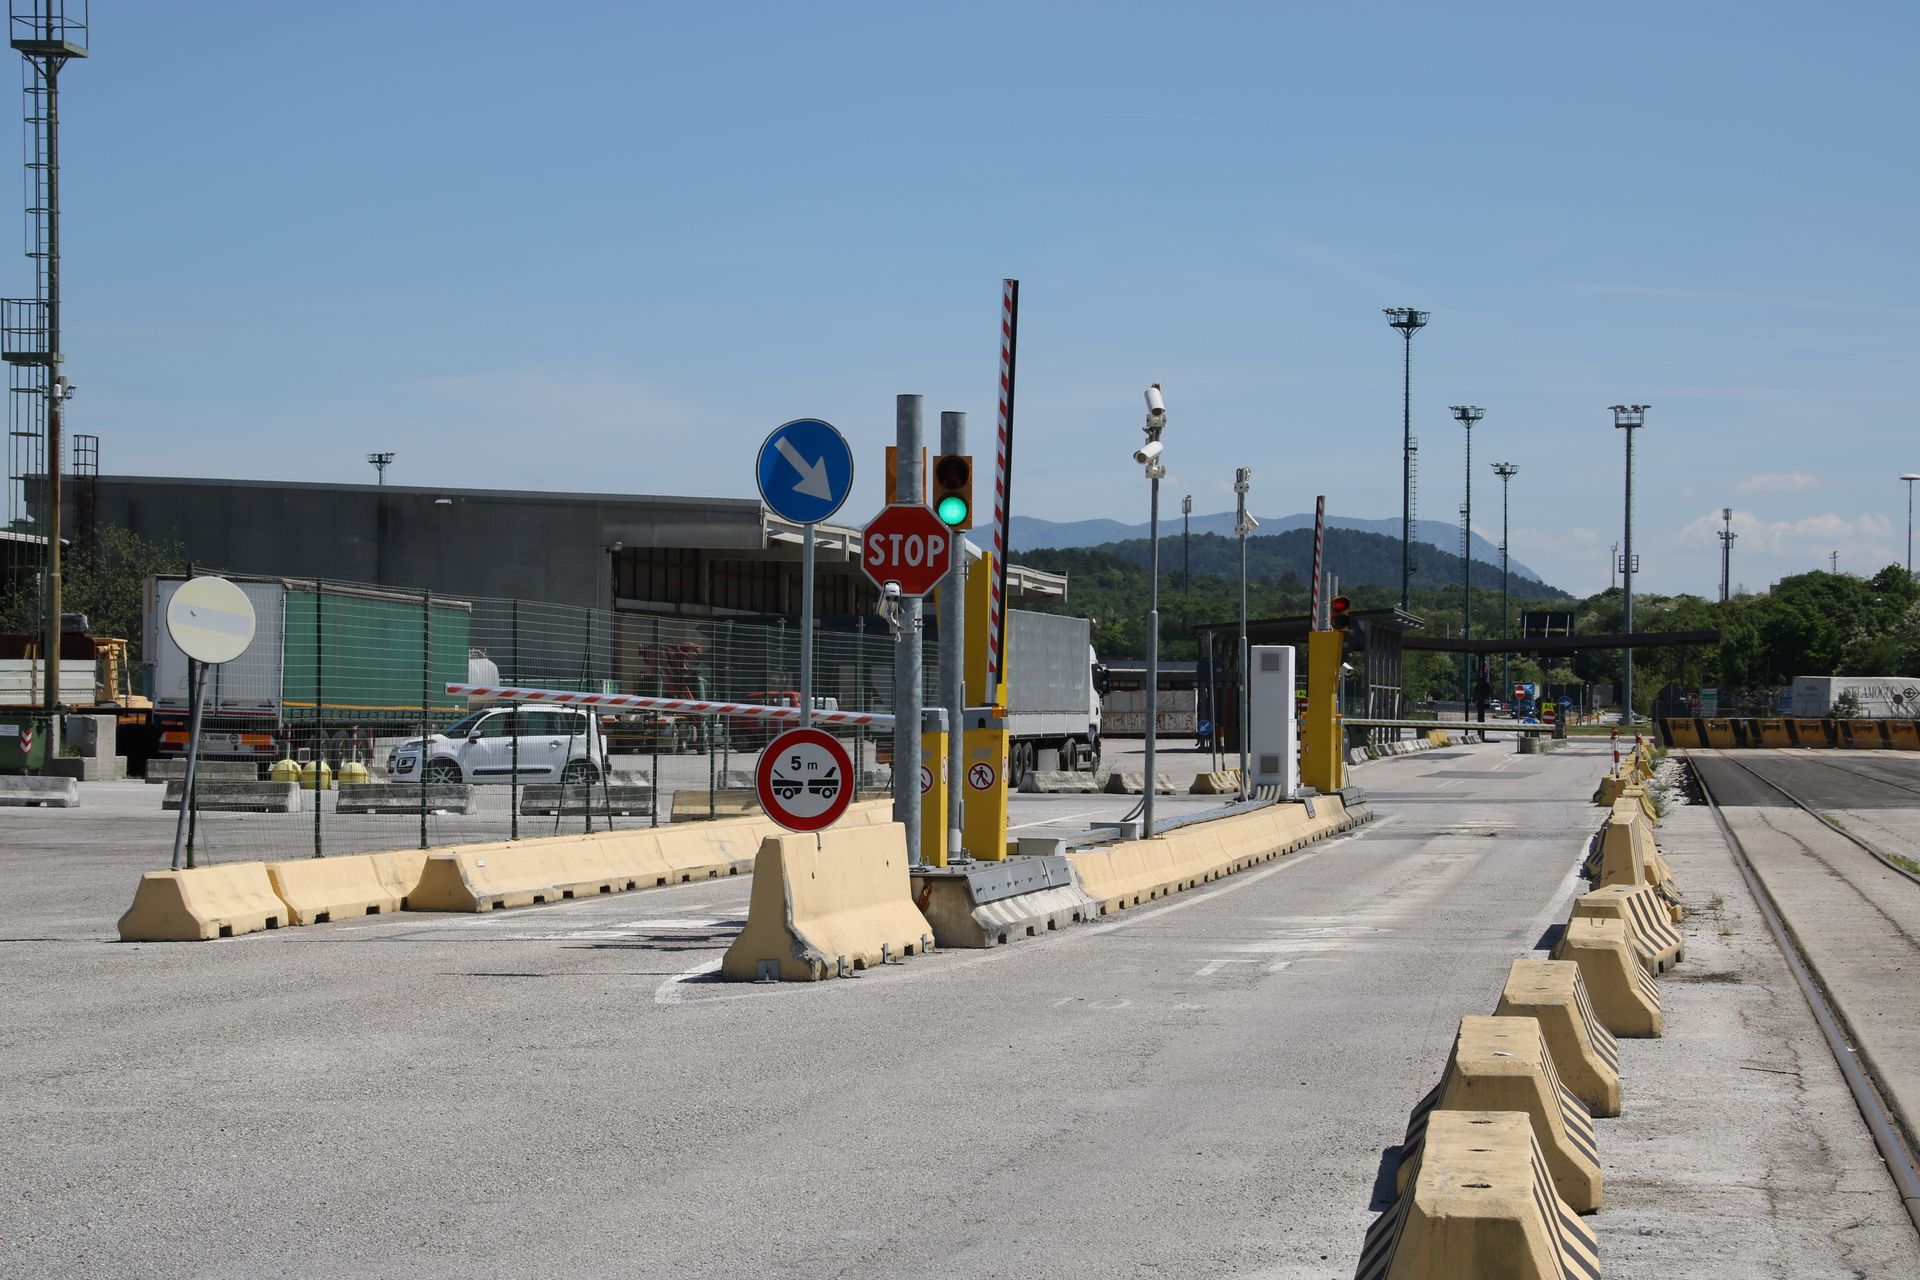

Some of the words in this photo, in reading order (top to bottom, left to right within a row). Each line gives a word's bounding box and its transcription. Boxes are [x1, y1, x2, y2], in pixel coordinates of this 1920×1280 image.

[868, 533, 945, 567] STOP
[791, 756, 802, 771] 5
[807, 762, 818, 770] m
